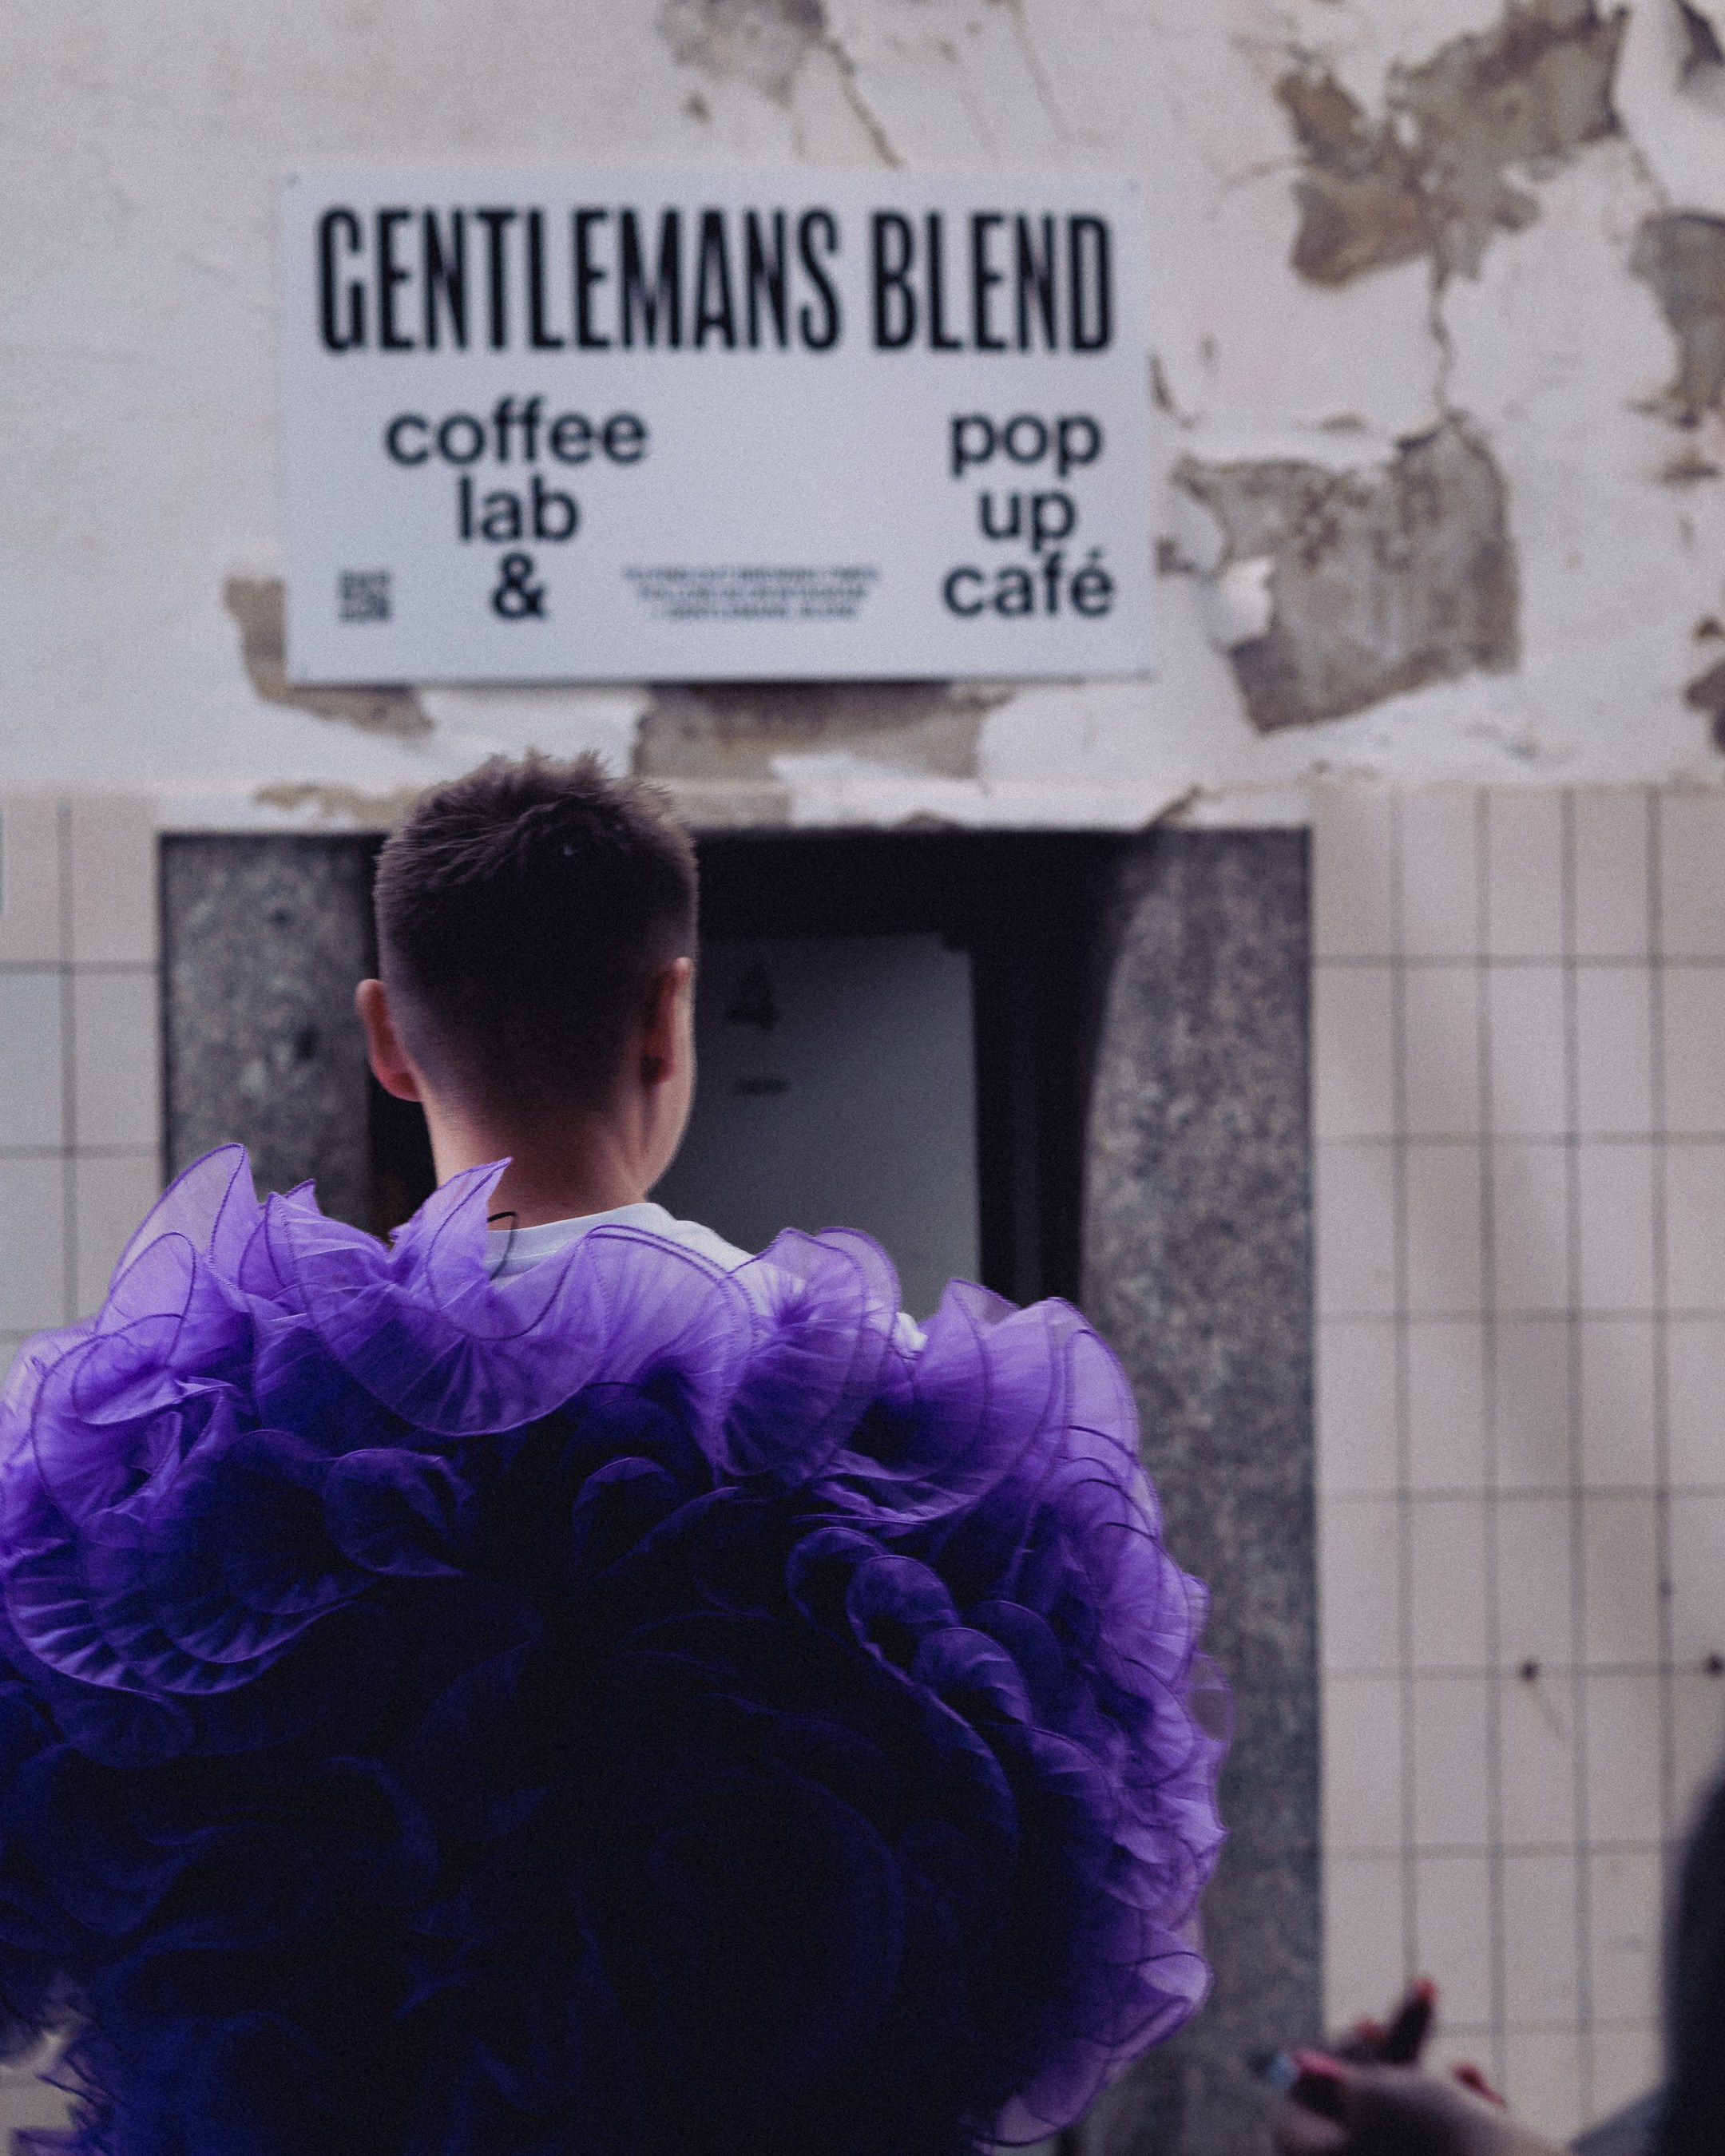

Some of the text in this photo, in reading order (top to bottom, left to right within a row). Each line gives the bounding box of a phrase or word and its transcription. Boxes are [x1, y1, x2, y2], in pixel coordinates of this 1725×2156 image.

[318, 206, 1113, 354] GENTLEMANS BLEND
[385, 397, 647, 469] coffee
[950, 414, 1103, 481] pop
[458, 475, 580, 542] lab
[980, 491, 1077, 550] up
[491, 553, 546, 620] &
[943, 547, 1114, 620] café
